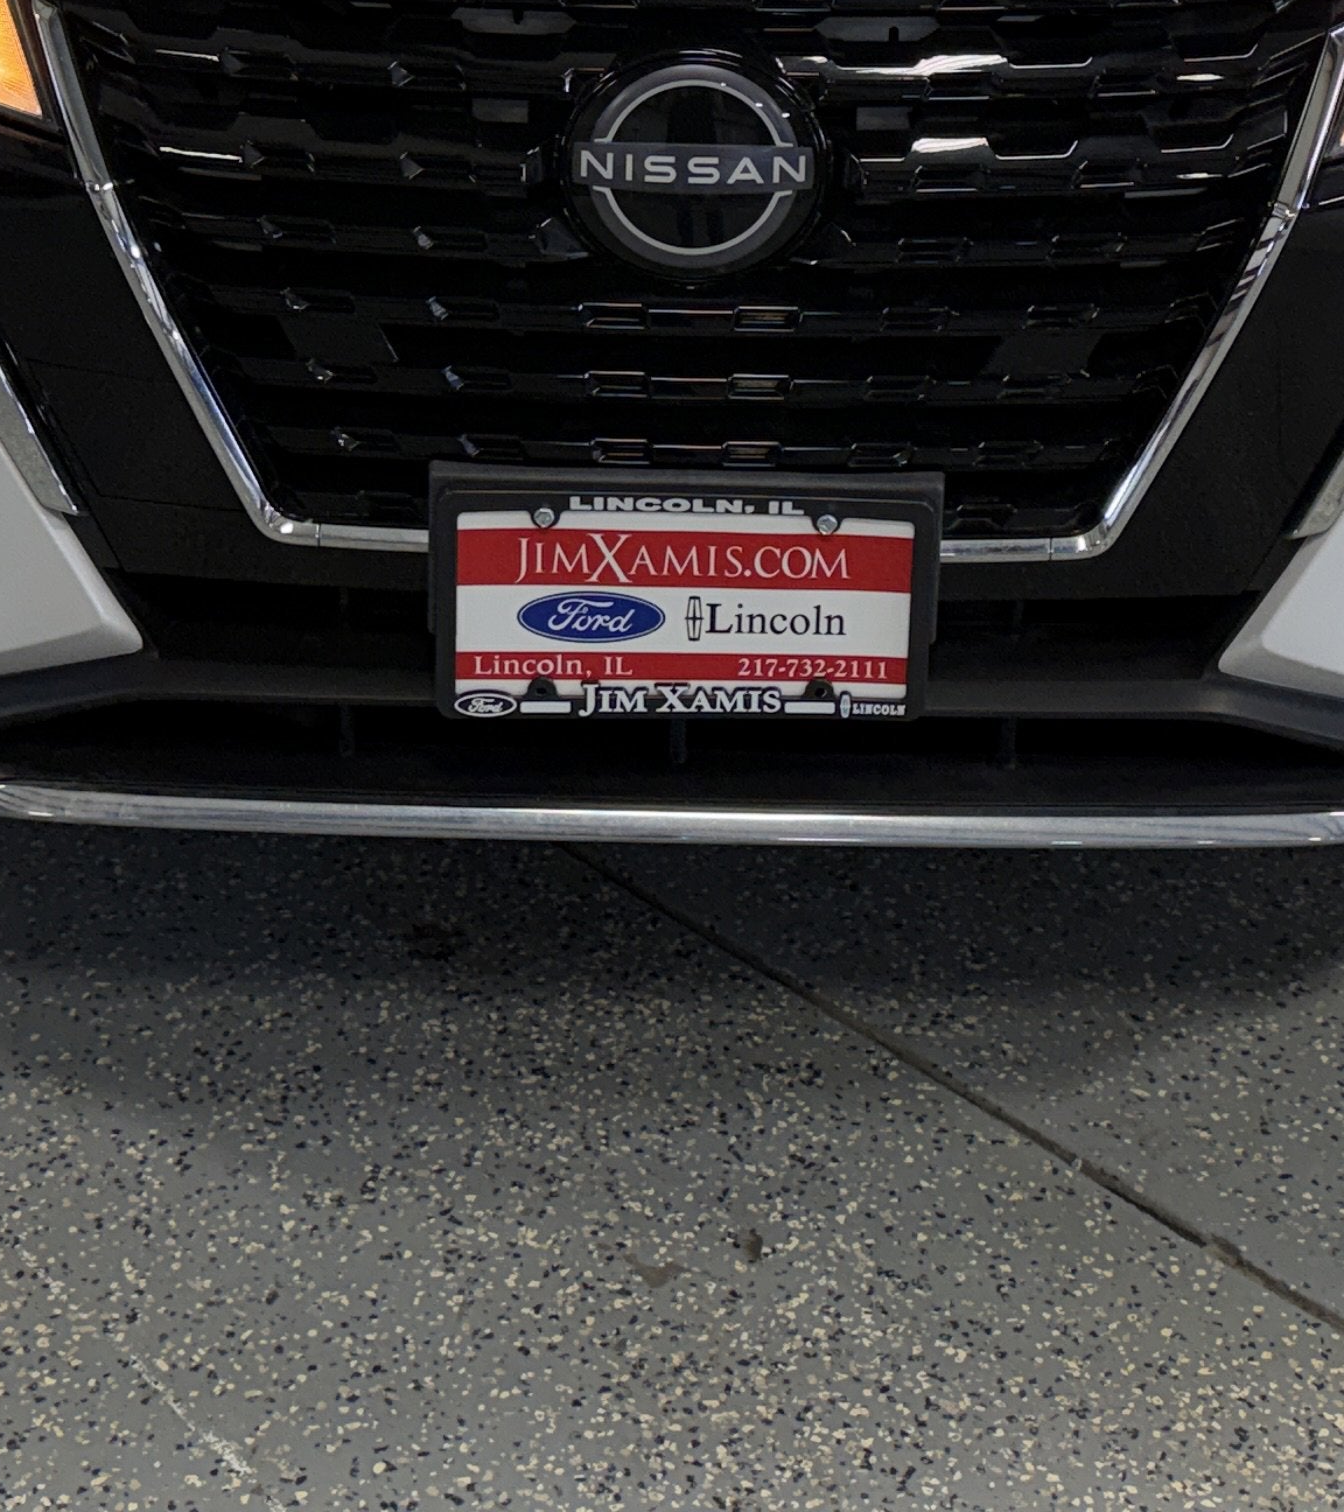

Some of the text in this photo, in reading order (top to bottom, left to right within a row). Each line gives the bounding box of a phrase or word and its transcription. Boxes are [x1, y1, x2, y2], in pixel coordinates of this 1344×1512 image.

[579, 149, 806, 185] NISSAN
[569, 495, 805, 516] LINCOLN, IL
[546, 597, 635, 635] Ford
[705, 602, 846, 636] Lincoln
[474, 654, 633, 678] Lincoln, IL
[737, 657, 888, 679] 217-732-2111
[467, 698, 504, 714] Ford
[578, 683, 782, 717] JIM XAMIS
[852, 703, 906, 716] LINCOLN
